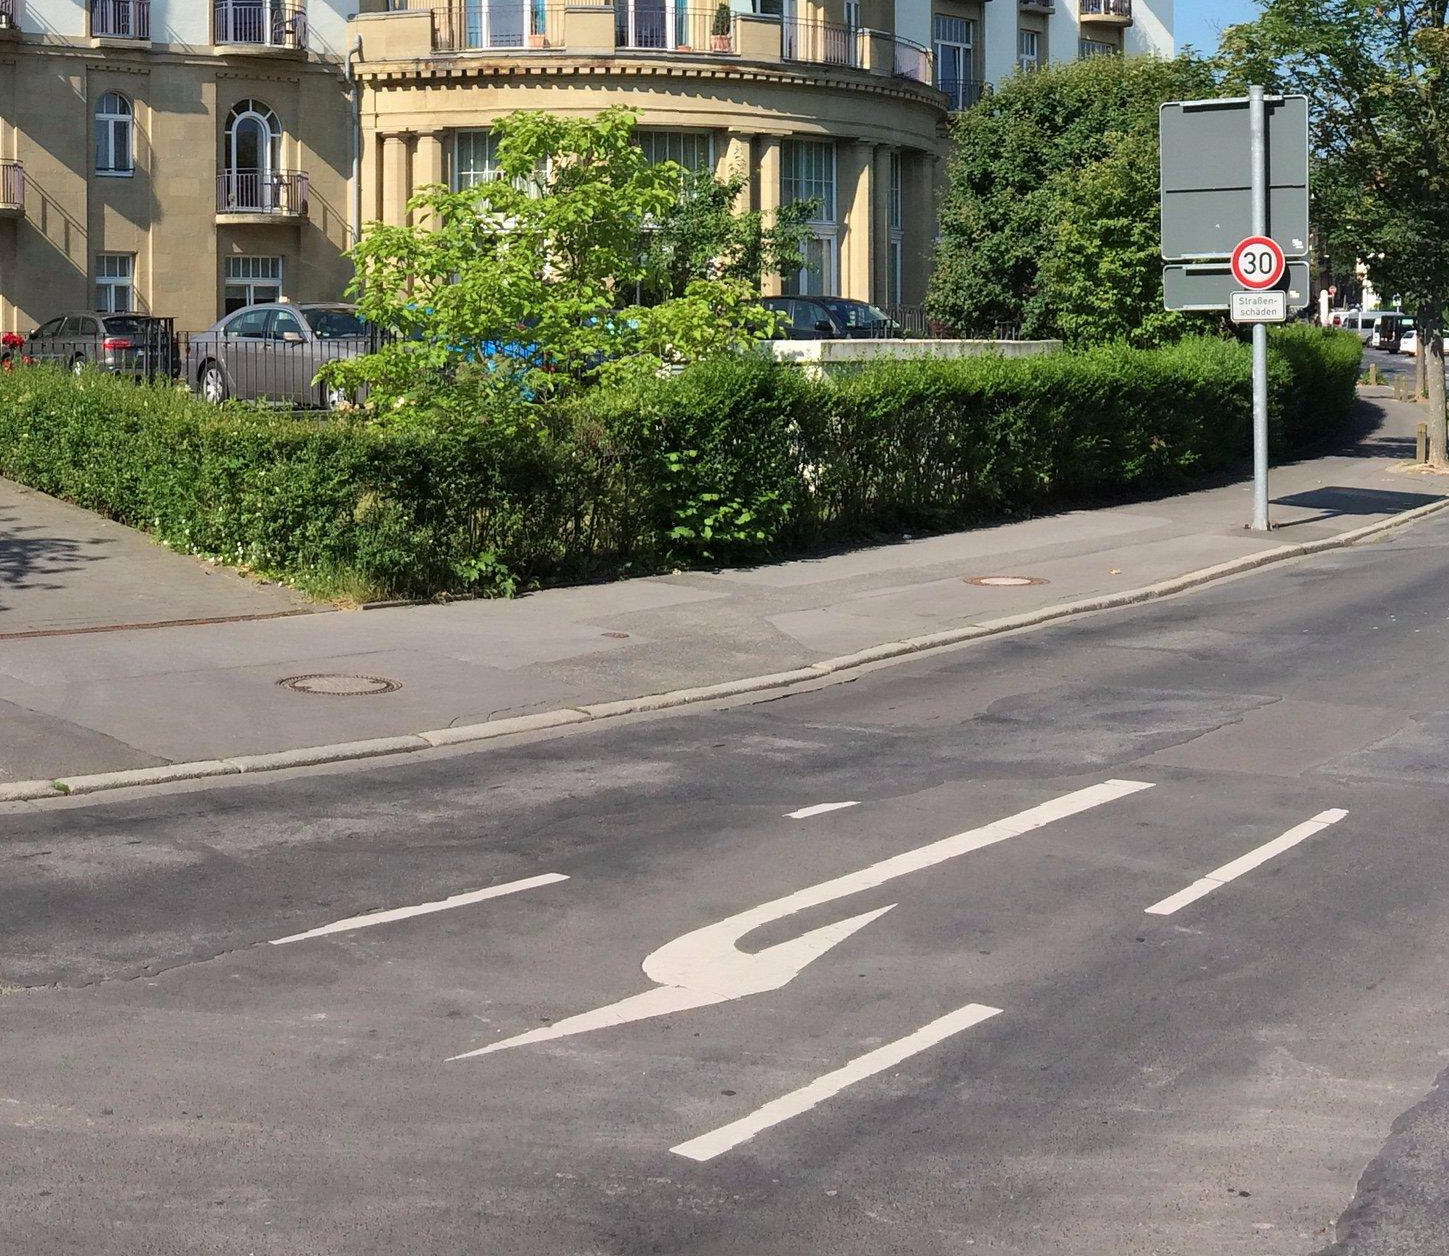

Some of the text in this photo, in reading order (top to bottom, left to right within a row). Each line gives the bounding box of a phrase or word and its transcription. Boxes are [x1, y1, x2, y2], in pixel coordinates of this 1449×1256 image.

[1243, 252, 1272, 274] 30
[1239, 297, 1278, 305] Straßen-
[1240, 308, 1277, 316] schäden
